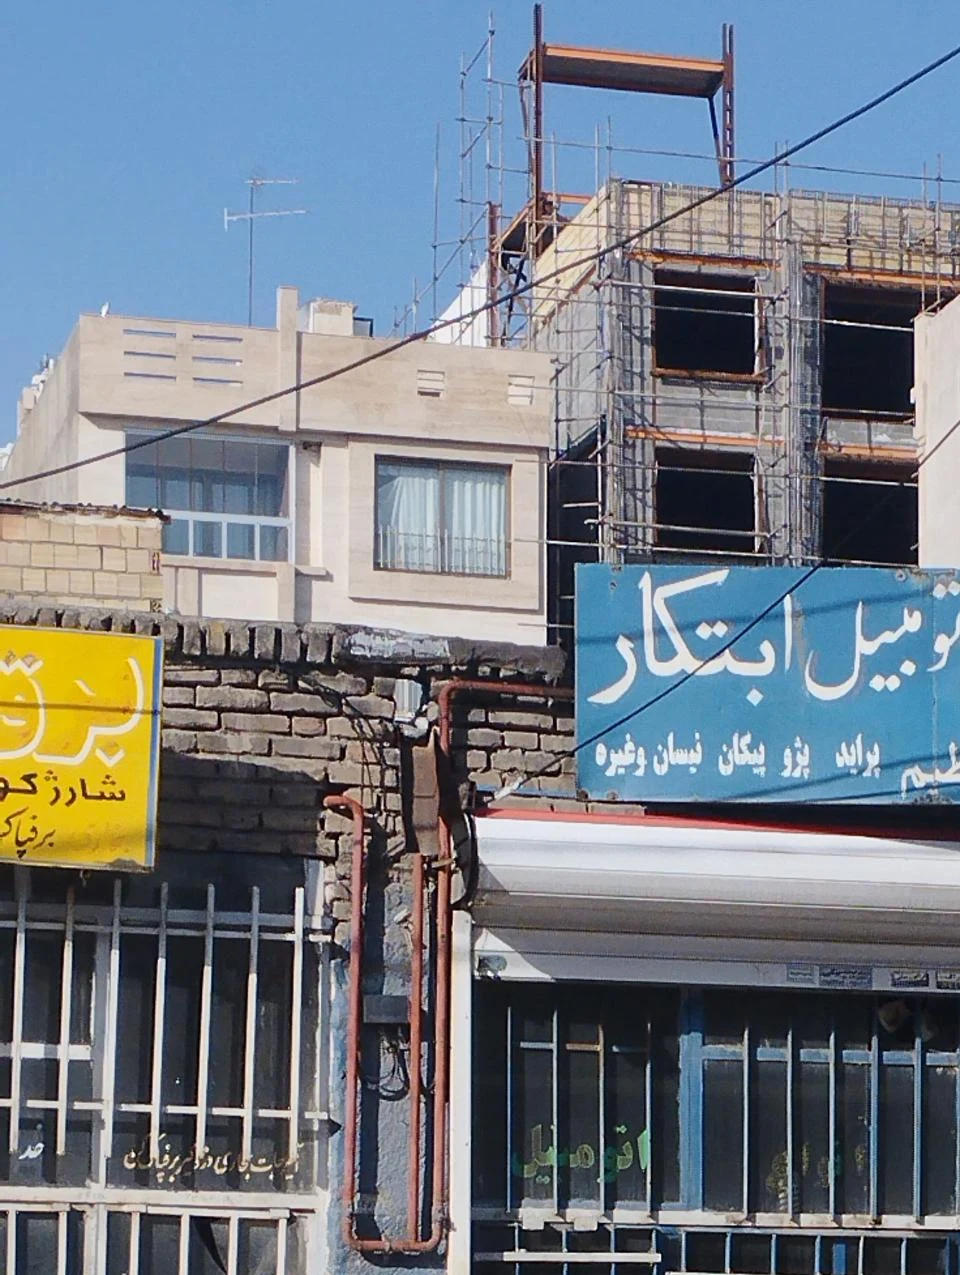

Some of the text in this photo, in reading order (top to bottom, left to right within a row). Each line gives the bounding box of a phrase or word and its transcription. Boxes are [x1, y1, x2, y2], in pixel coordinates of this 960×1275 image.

[587, 568, 795, 707] ابتکار
[653, 731, 702, 776] نیسان
[718, 731, 766, 777] پیکان
[779, 735, 810, 779] پژو
[835, 733, 880, 779] پراید
[44, 769, 126, 807] شارژ
